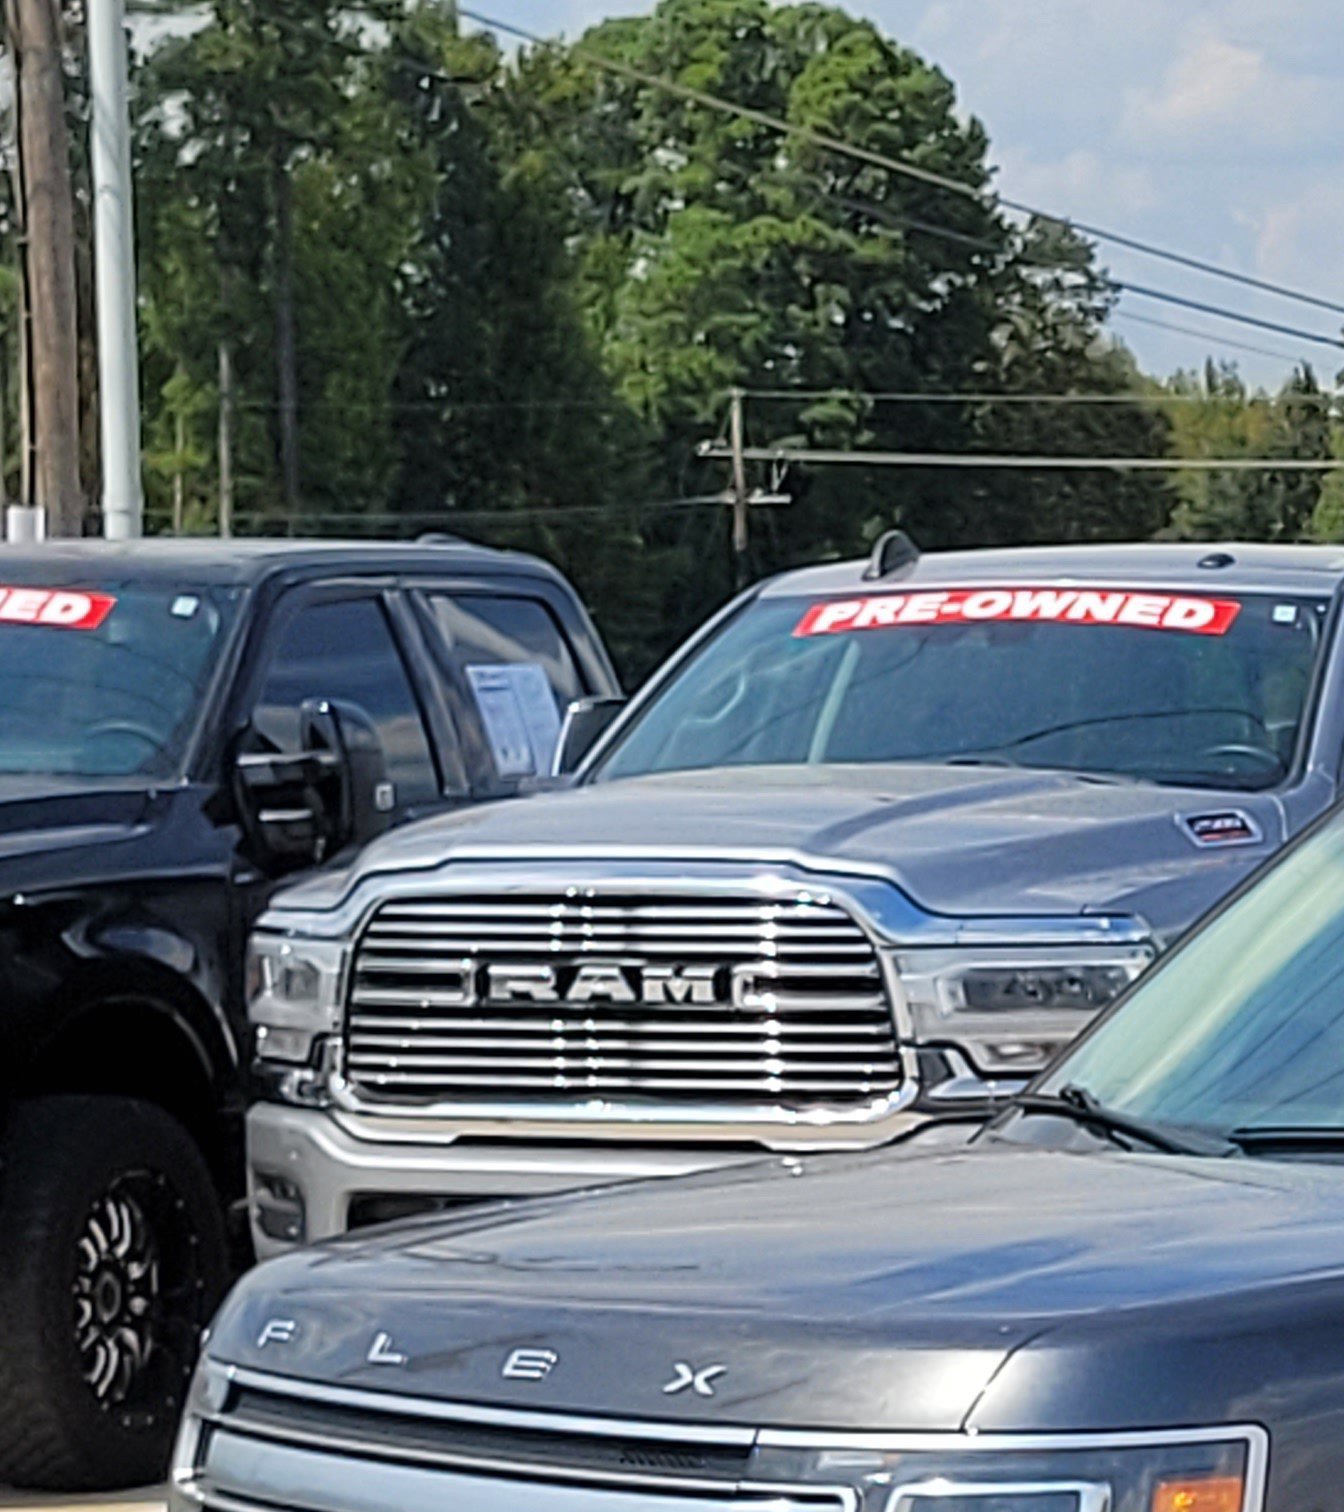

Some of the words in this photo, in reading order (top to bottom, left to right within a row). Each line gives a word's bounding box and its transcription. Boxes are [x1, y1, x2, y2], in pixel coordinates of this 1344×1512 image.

[0, 588, 92, 625] ED
[811, 590, 1216, 631] PRE-OWNED
[487, 963, 718, 1002] RAM
[257, 1319, 728, 1397] FLEX
